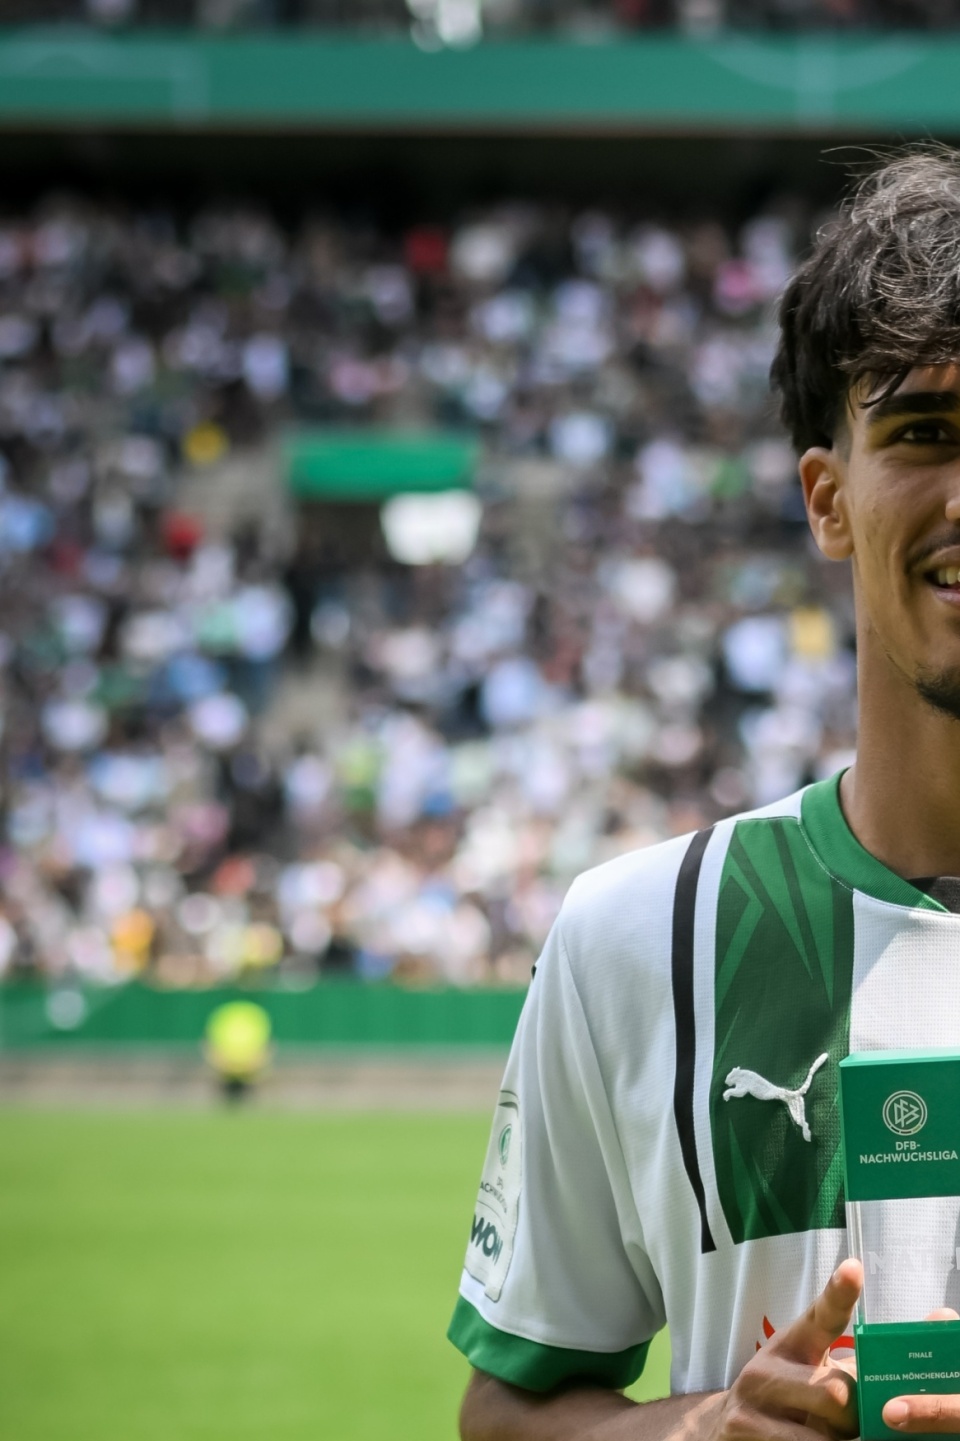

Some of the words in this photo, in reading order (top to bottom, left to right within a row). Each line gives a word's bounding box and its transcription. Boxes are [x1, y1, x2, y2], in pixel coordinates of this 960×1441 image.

[895, 1141, 921, 1151] DFB-
[859, 1150, 959, 1164] NACHWUCHSLIGA
[864, 1373, 901, 1382] BORUSSIA
